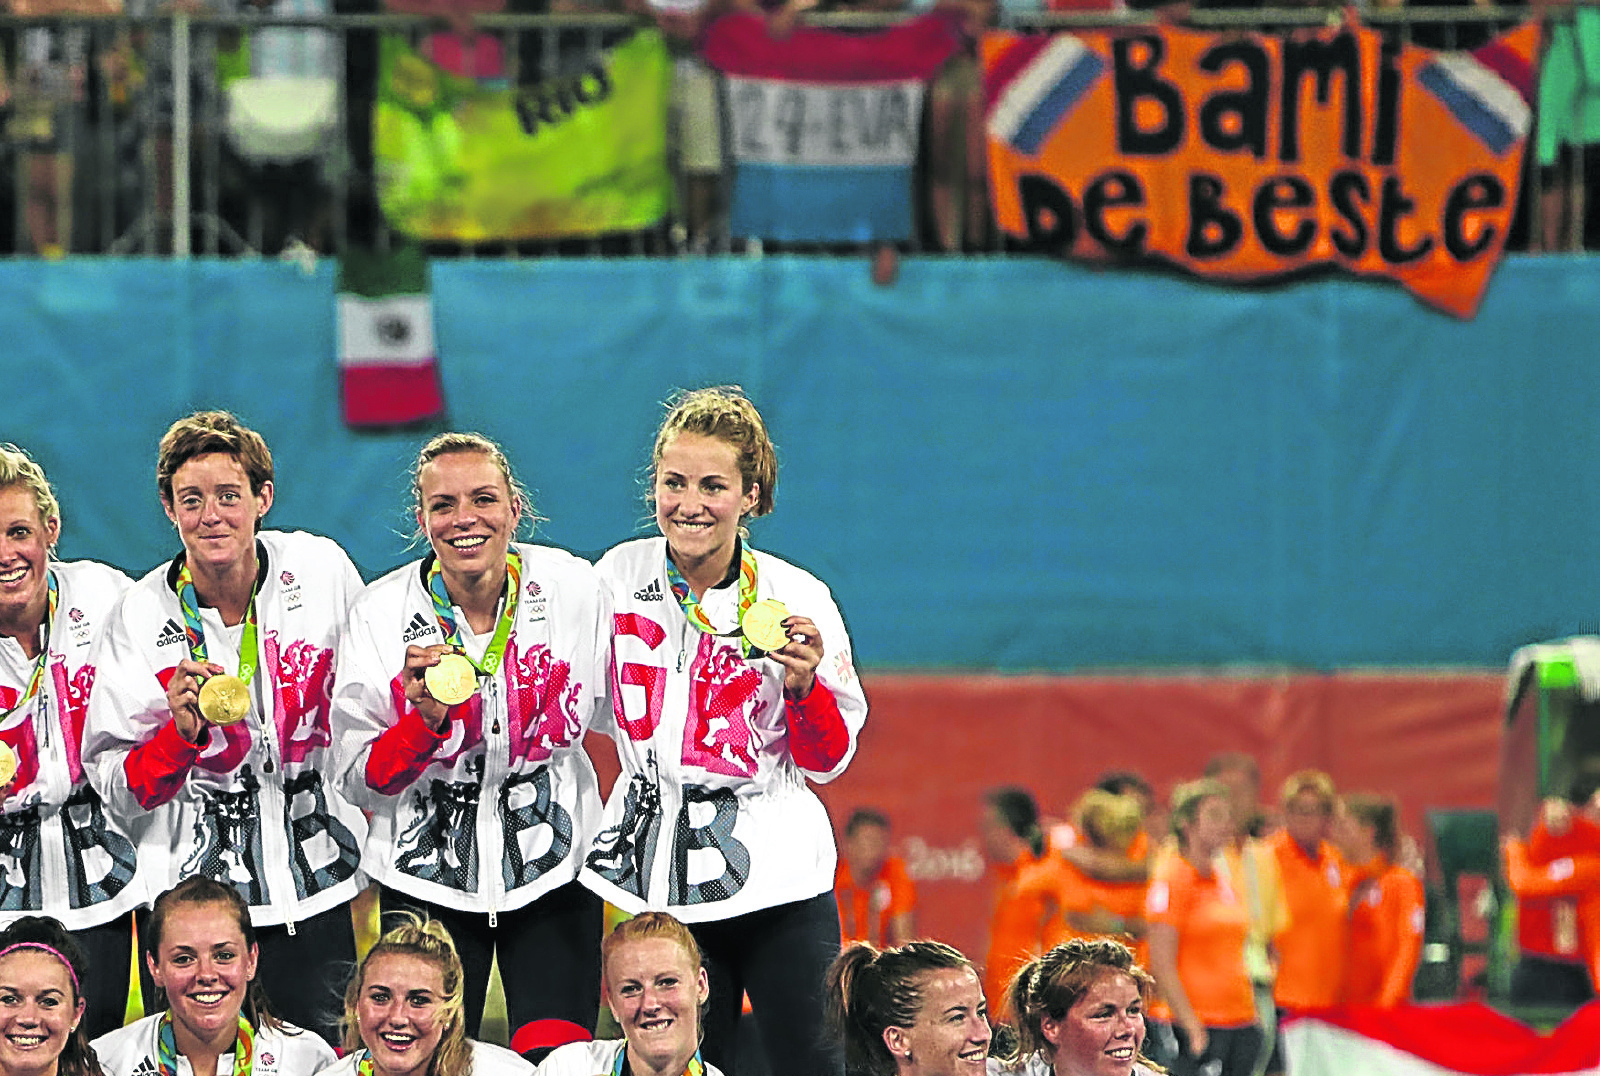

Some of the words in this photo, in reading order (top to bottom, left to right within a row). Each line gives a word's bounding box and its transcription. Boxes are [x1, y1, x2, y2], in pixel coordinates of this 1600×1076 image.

[1113, 33, 1399, 165] Bami
[1186, 171, 1505, 263] Beste
[402, 624, 438, 644] adidas
[633, 589, 664, 603] adidas
[611, 613, 668, 742] G
[668, 784, 751, 907] B
